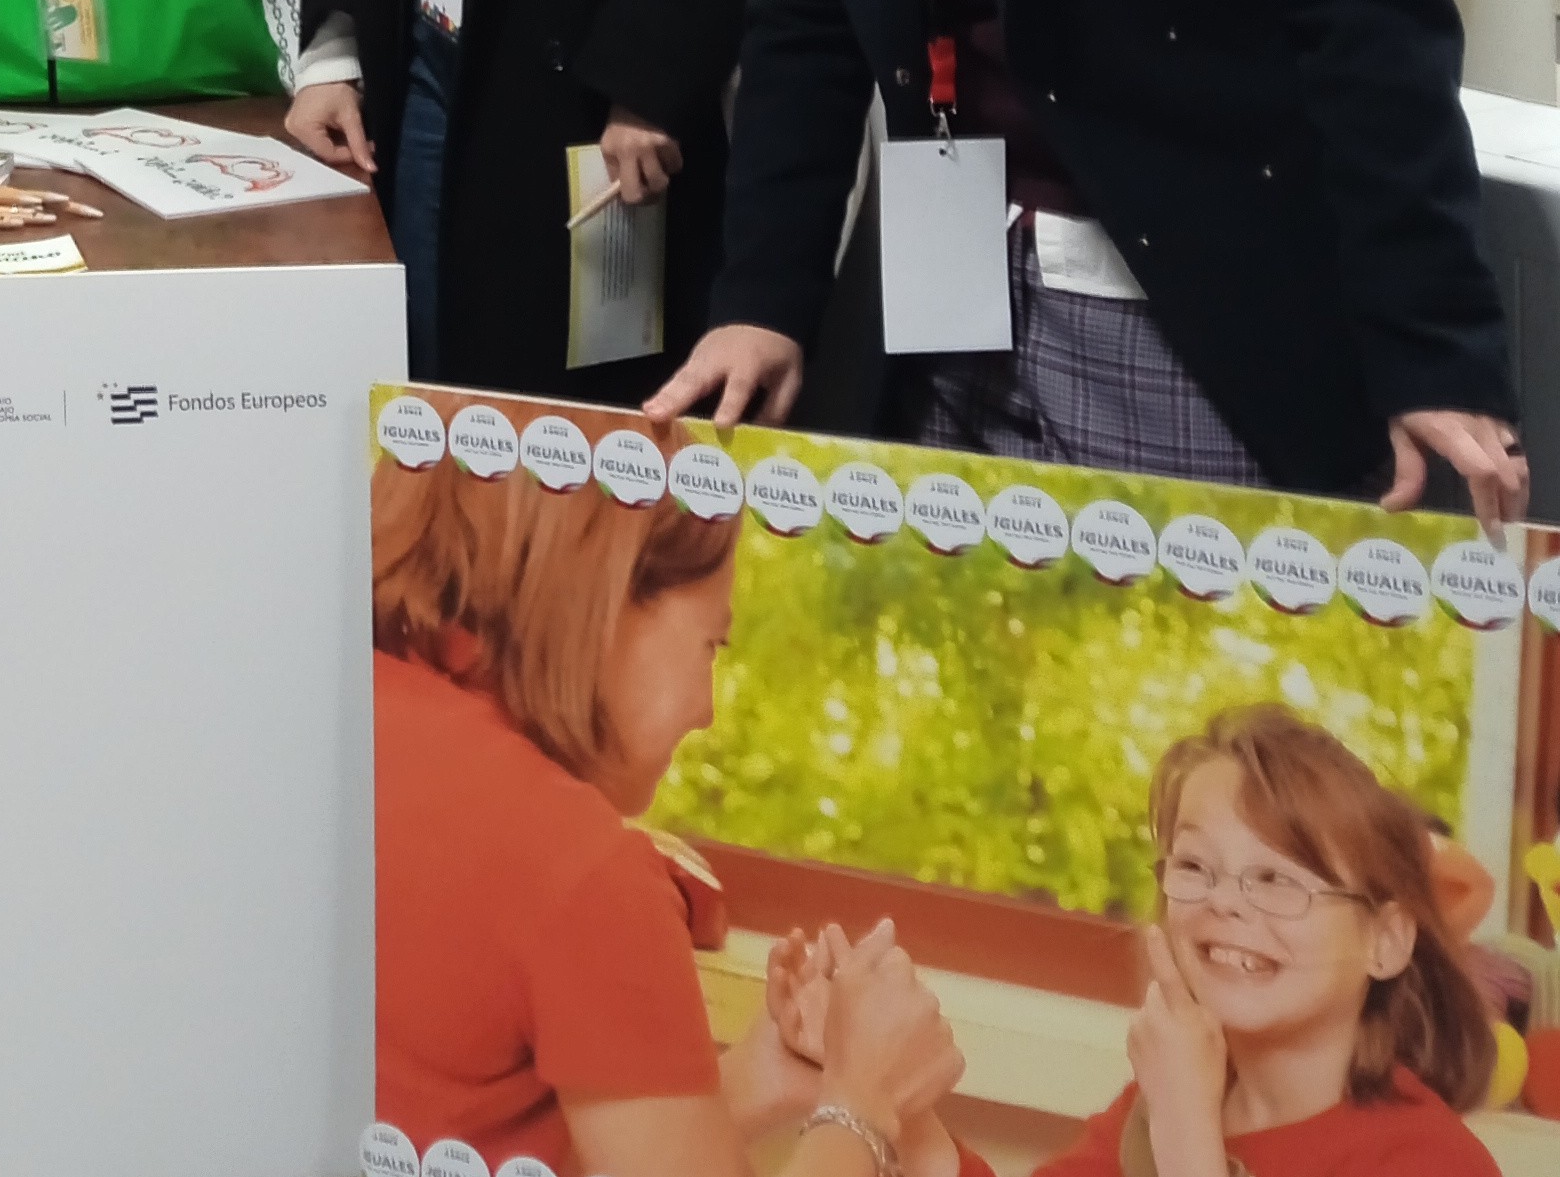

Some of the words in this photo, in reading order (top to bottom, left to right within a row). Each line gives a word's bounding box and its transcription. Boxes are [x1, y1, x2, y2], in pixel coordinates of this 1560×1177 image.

[167, 393, 236, 412] Fondos
[240, 391, 329, 410] Europeos
[22, 414, 51, 422] SOCIAL
